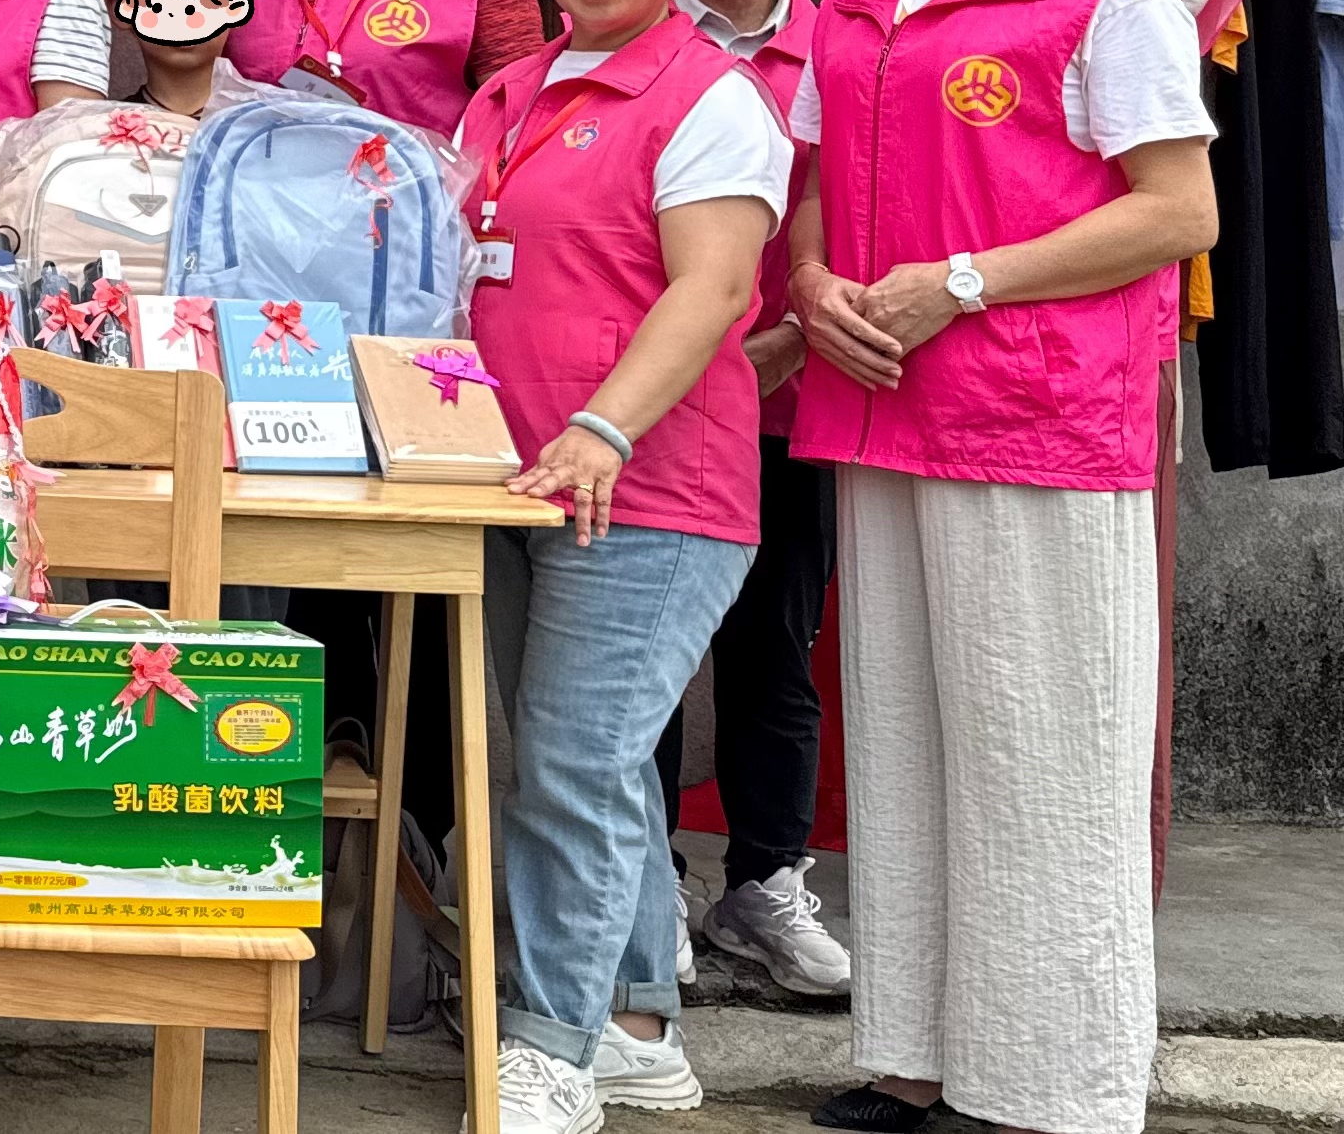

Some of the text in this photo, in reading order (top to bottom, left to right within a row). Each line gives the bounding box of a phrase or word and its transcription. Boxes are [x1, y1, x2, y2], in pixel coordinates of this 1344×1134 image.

[32, 646, 111, 664] SHAN
[188, 650, 245, 667] CAO
[248, 652, 301, 669] NAI
[112, 783, 285, 815] 乳酸菌饮料
